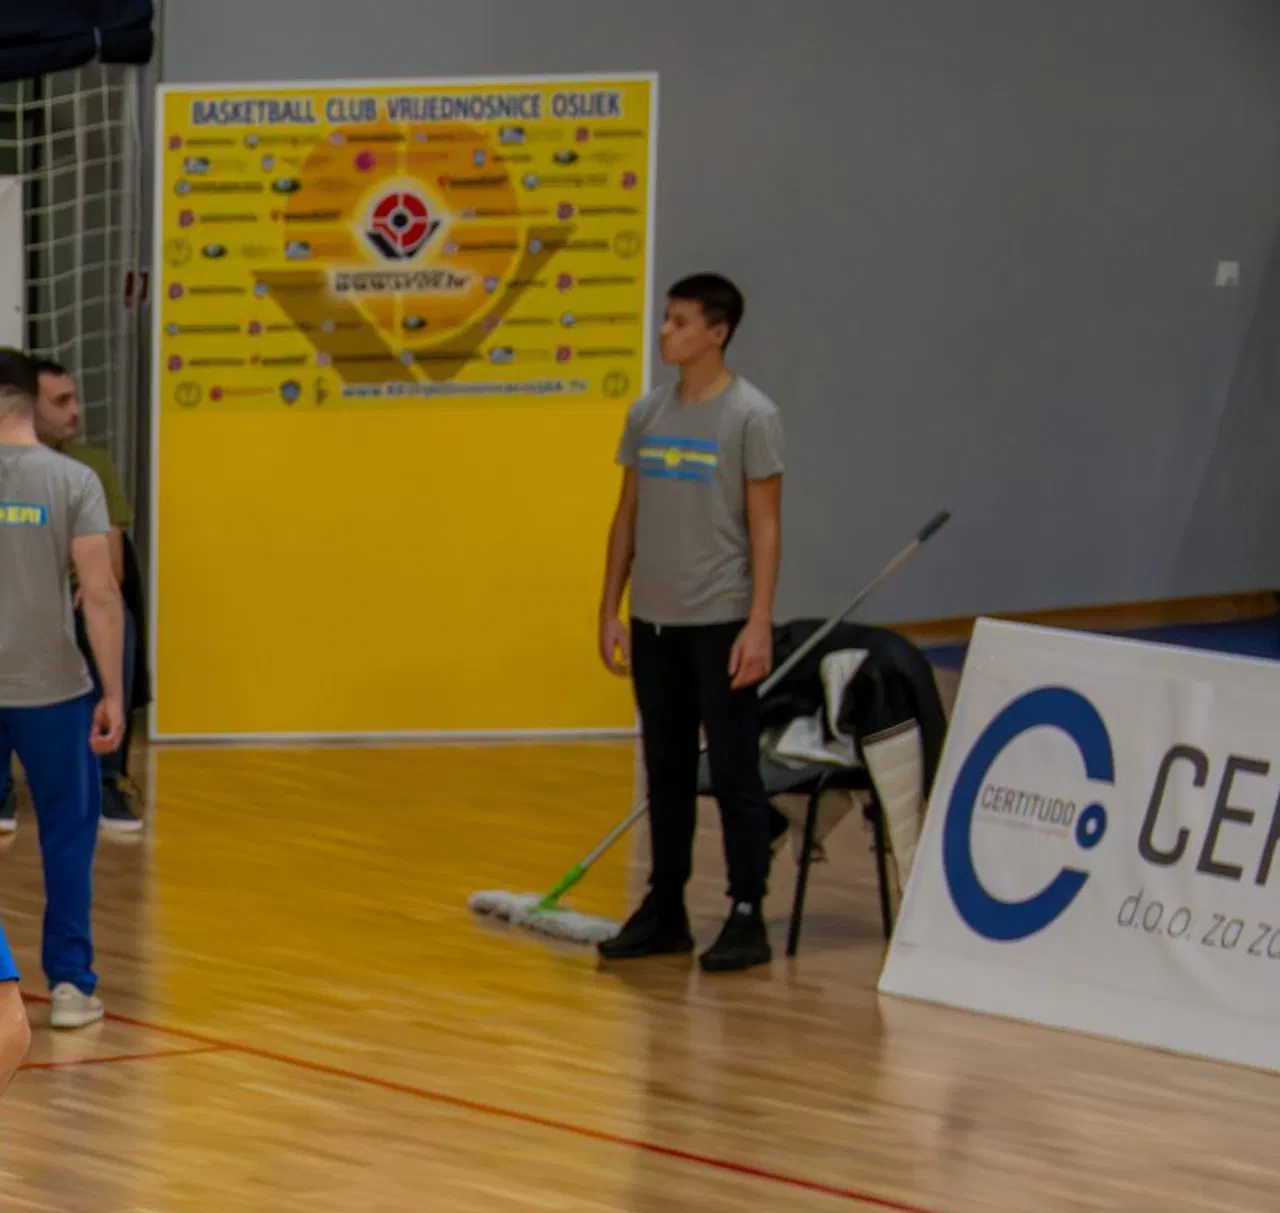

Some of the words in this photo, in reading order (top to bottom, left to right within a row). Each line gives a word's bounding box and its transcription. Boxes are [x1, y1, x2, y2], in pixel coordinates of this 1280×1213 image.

[326, 96, 377, 124] CLUB
[552, 91, 622, 118] OSIJEK
[980, 783, 1076, 827] CERTITUDO
[1117, 887, 1192, 942] d.o.o.
[1200, 911, 1245, 950] za
